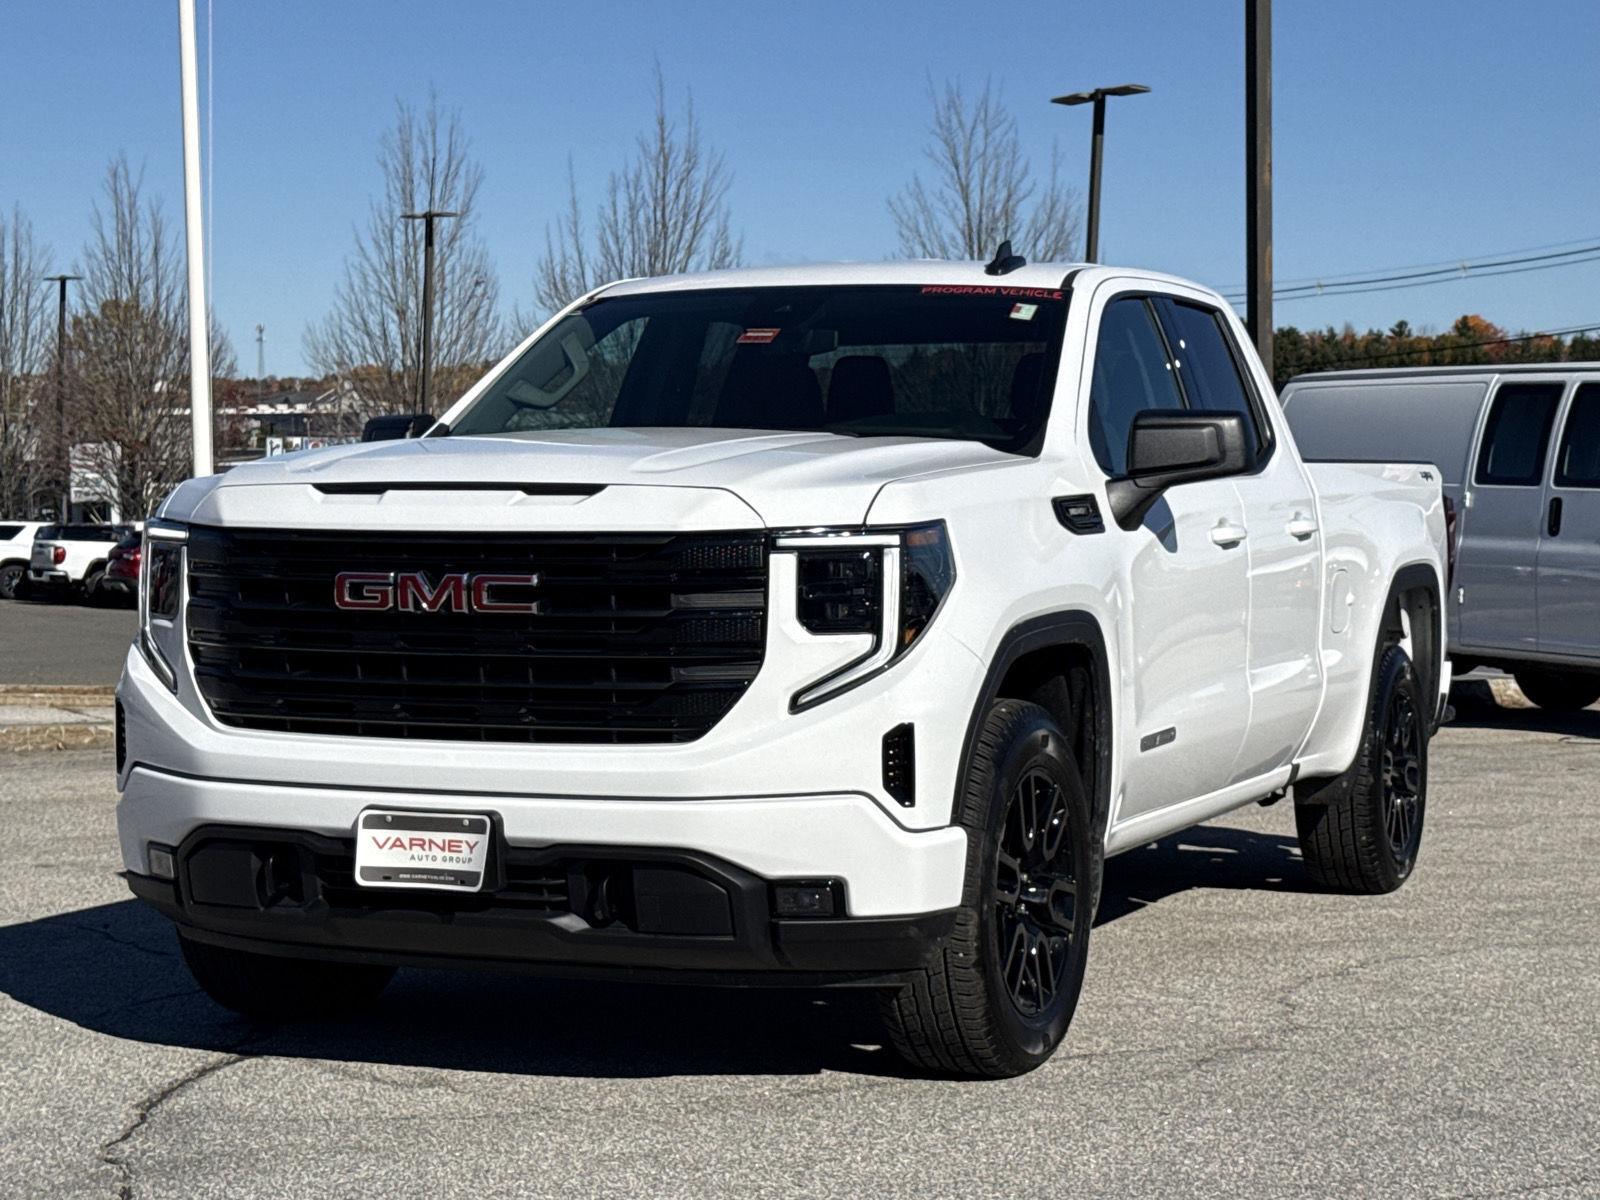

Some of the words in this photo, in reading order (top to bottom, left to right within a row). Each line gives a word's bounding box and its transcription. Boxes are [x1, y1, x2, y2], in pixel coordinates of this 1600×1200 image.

[921, 286, 997, 295] PROGRAM
[999, 288, 1063, 300] VEHICLE
[334, 571, 538, 614] GMC
[371, 836, 480, 854] VARNEY
[409, 853, 437, 863] AUTO
[441, 855, 474, 864] GROUP
